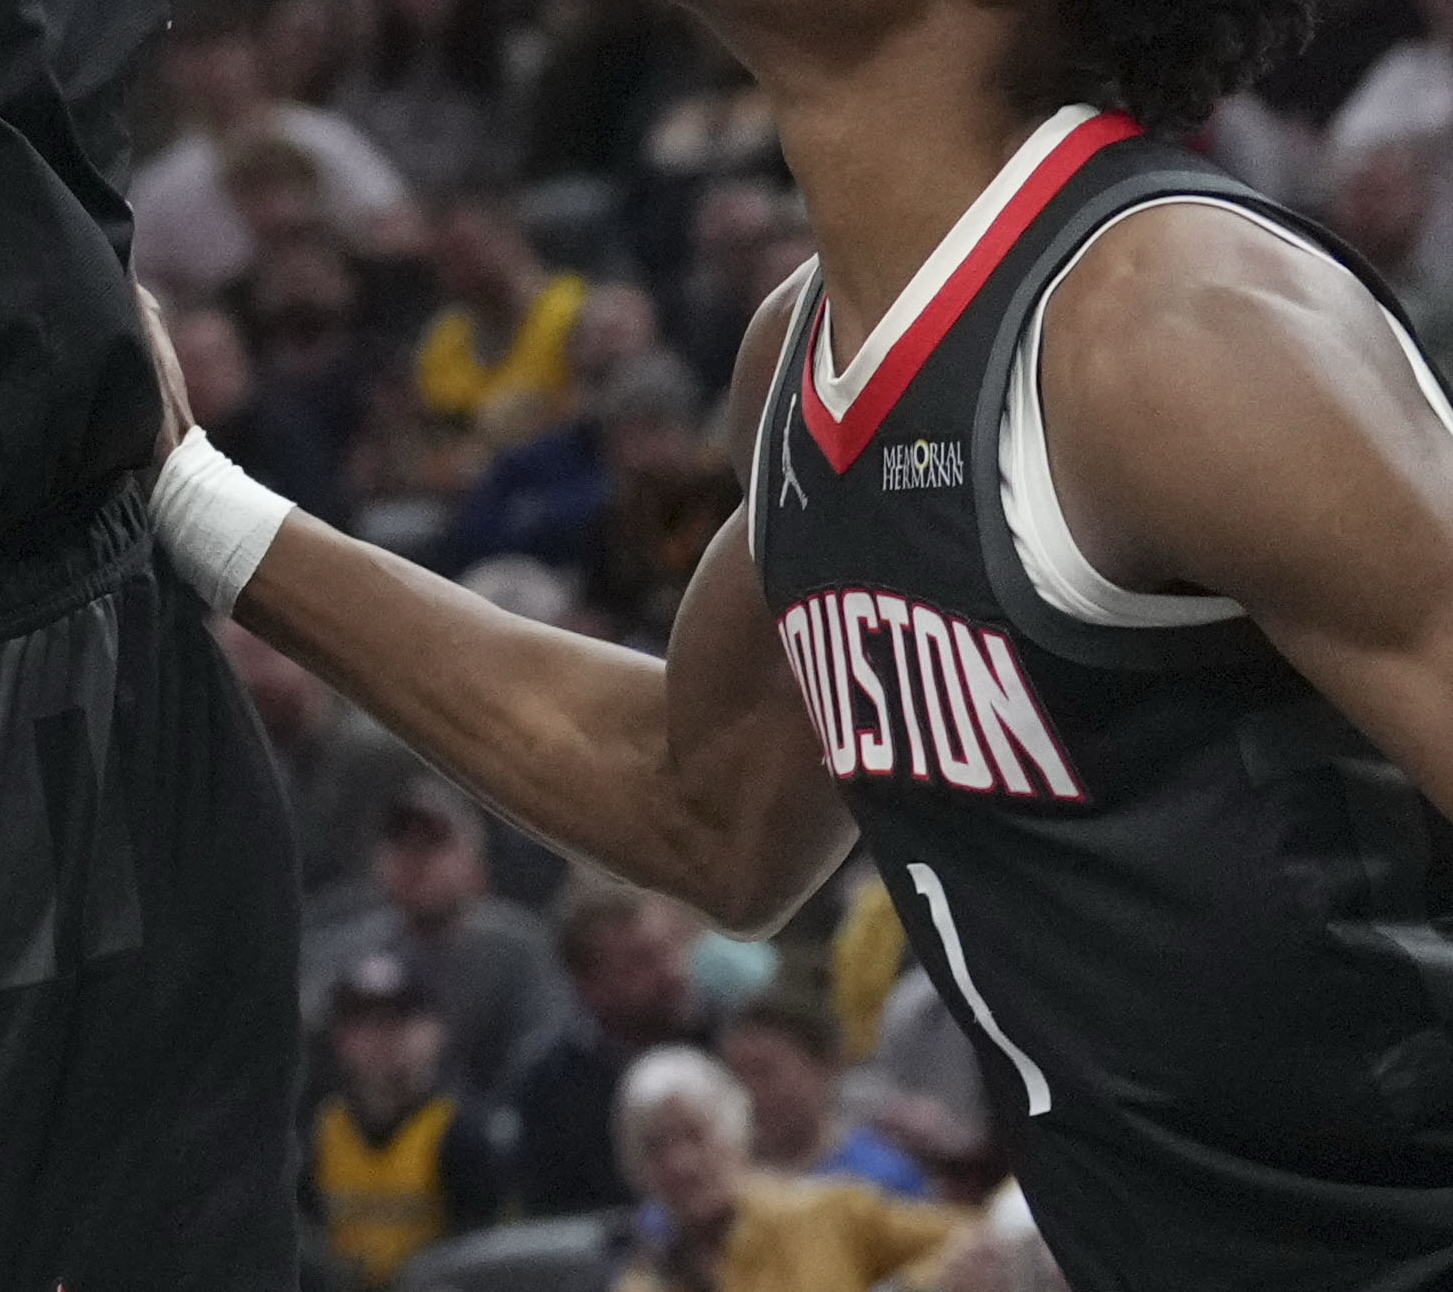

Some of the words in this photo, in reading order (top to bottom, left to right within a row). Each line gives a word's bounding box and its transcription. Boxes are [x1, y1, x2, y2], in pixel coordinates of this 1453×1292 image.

[882, 464, 964, 491] HERMANN
[883, 439, 964, 469] MEMORIAL
[777, 588, 1088, 803] OUSTON
[907, 862, 1052, 1117] 1
